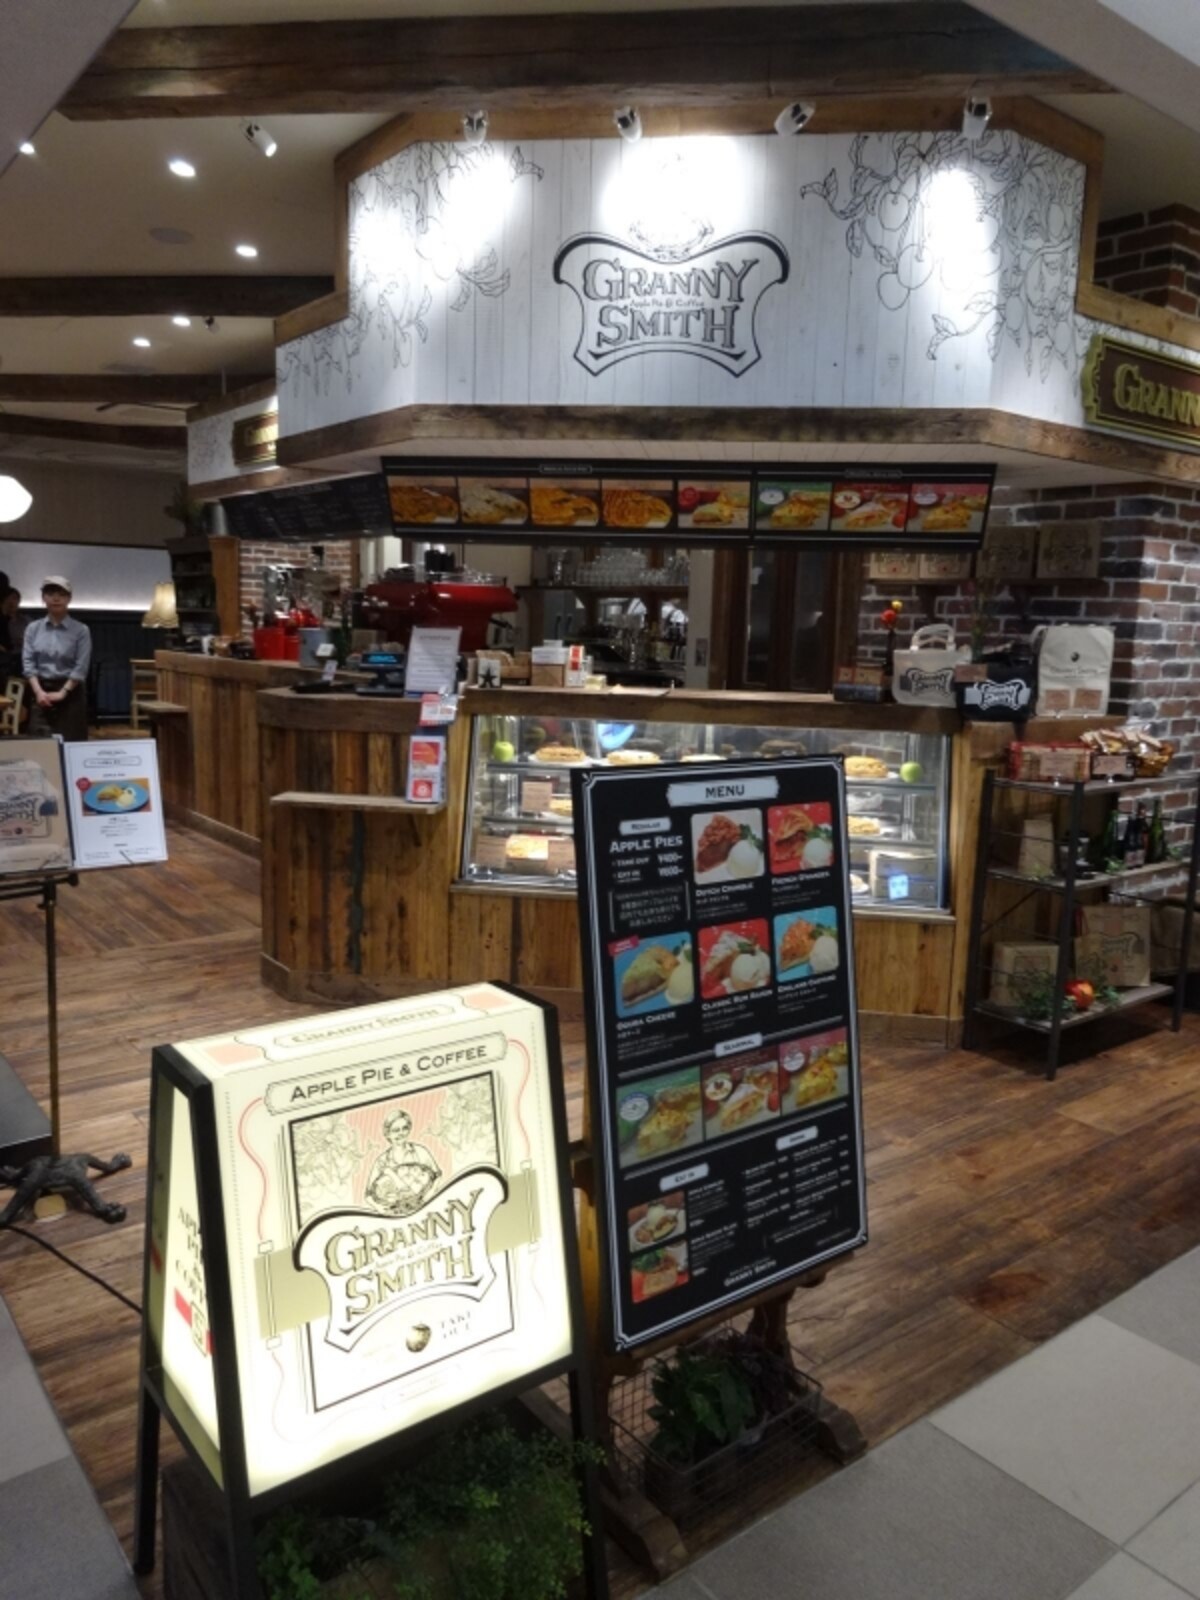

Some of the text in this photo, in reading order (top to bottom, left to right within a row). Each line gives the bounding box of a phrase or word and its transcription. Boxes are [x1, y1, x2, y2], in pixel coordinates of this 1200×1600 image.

[583, 257, 760, 303] GRANNY
[597, 304, 741, 349] SMITH
[704, 783, 746, 800] MENU
[609, 835, 684, 854] APPLE PIES
[290, 1045, 488, 1103] APPLE PIE & COFFEE
[324, 1187, 485, 1277] GRANNY
[345, 1234, 475, 1323] SMITH
